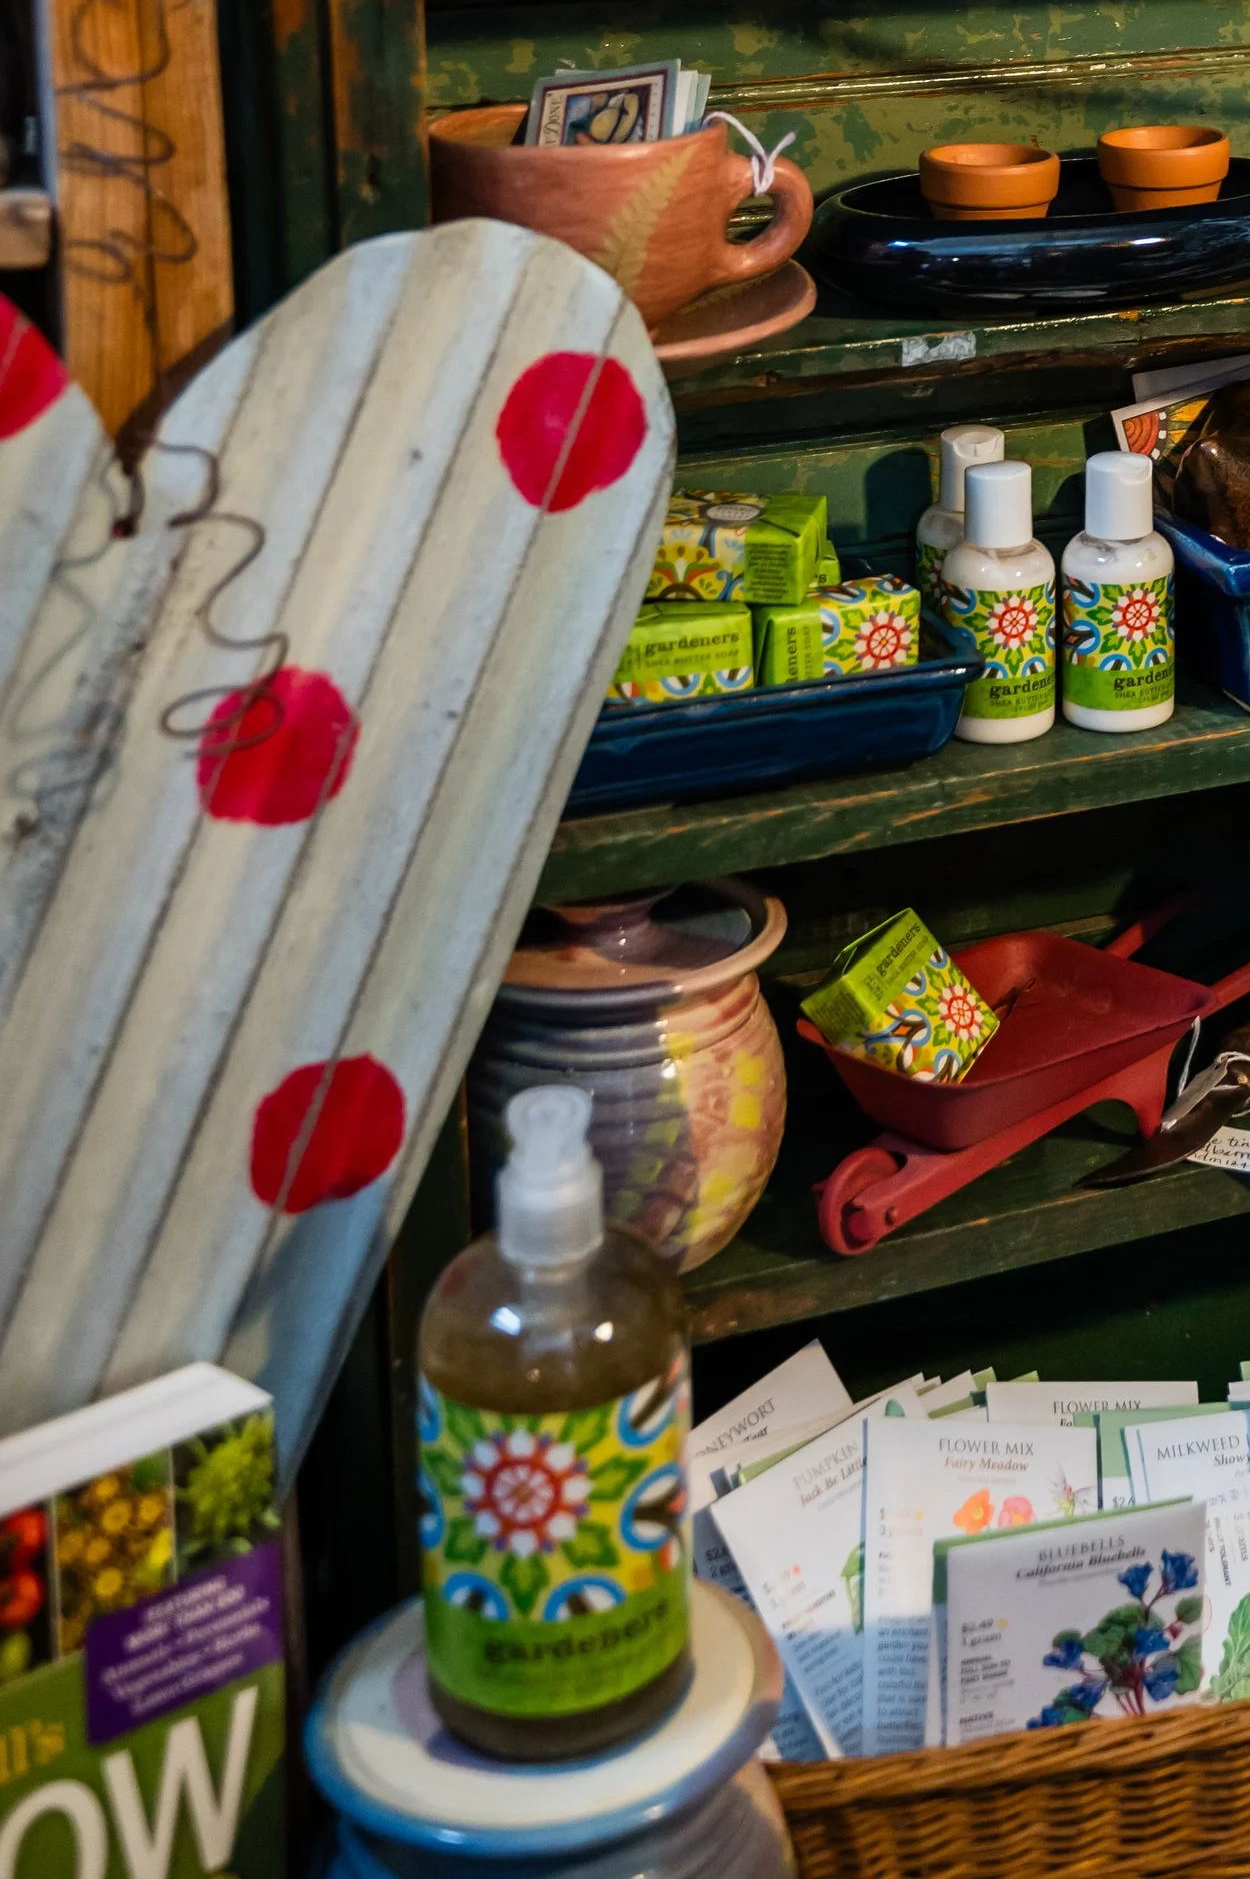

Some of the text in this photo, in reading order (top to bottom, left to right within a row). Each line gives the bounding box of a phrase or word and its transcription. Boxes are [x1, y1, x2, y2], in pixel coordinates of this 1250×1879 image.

[644, 631, 740, 656] gardeners
[876, 922, 921, 977] gardeners
[938, 1438, 1034, 1457] FLOWER MIX
[1156, 1435, 1240, 1461] MILKWEED
[1214, 1451, 1250, 1466] Showy
[794, 1440, 860, 1491] PUMPKIN
[944, 1456, 1029, 1472] Fairy Meadow
[1039, 1536, 1125, 1562] BLUEBELLS
[1015, 1546, 1145, 1579] California Bluebells
